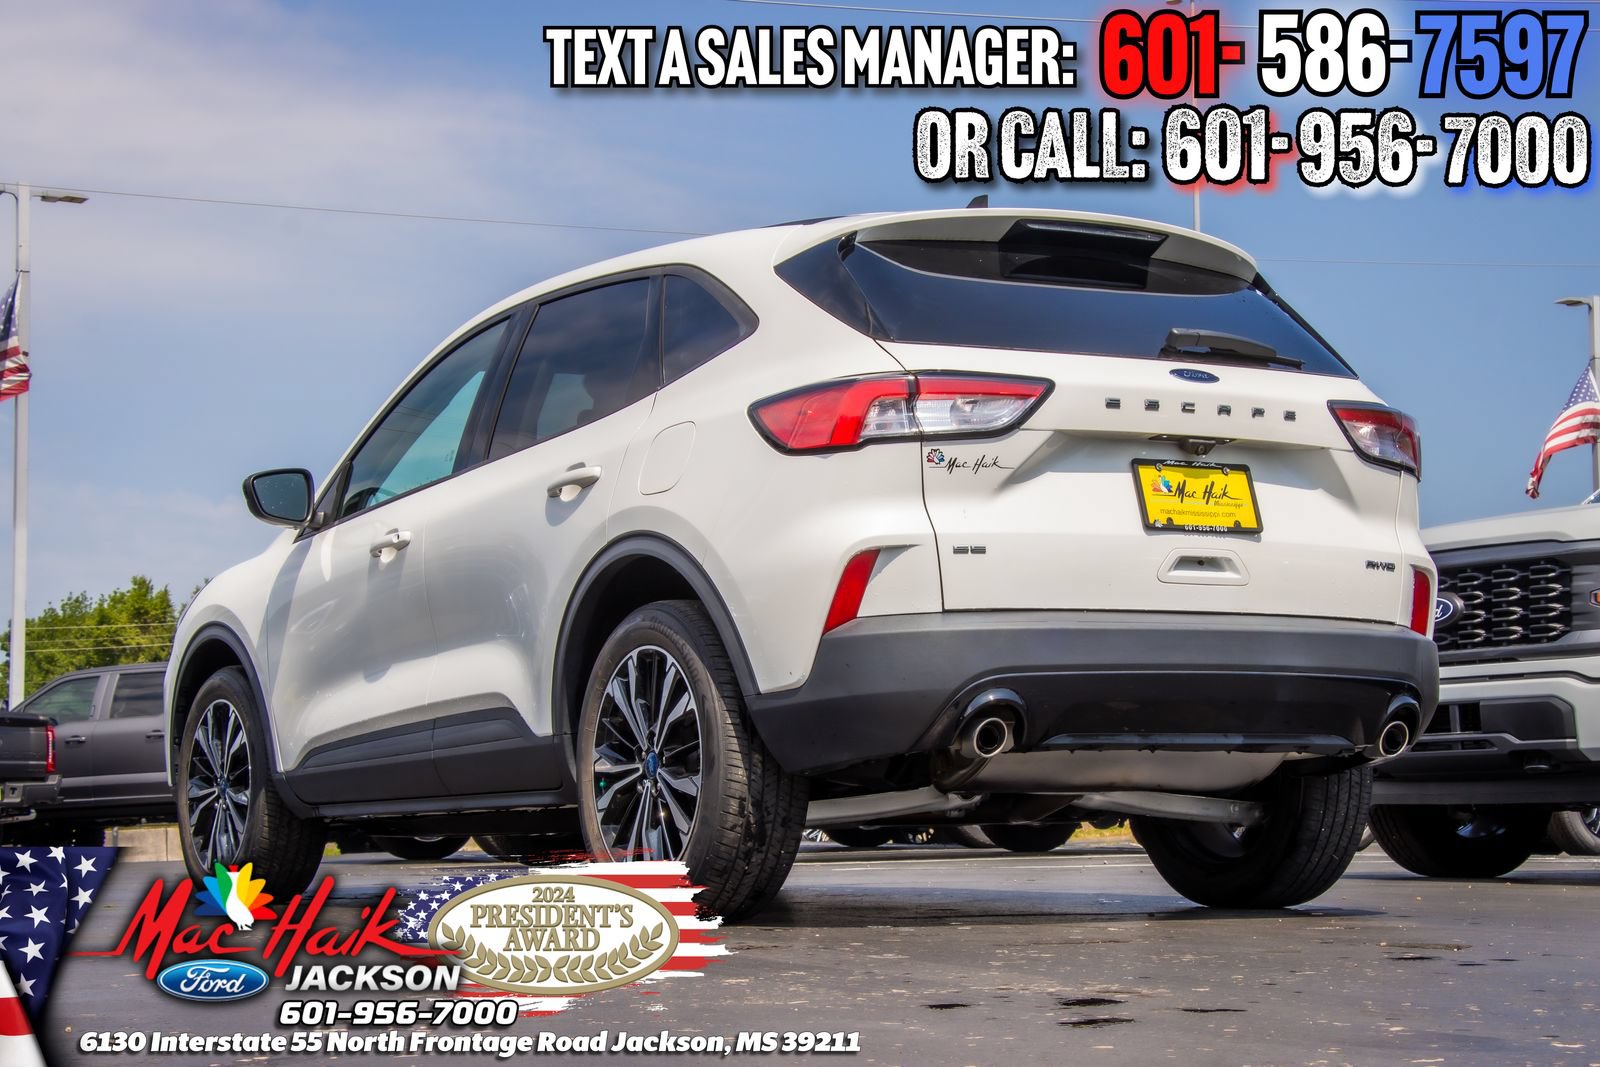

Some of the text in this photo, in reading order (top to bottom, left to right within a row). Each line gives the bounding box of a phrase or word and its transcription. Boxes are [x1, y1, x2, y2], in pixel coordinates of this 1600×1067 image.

[945, 454, 1006, 475] Mac Haik
[1172, 479, 1238, 505] Mac Haik
